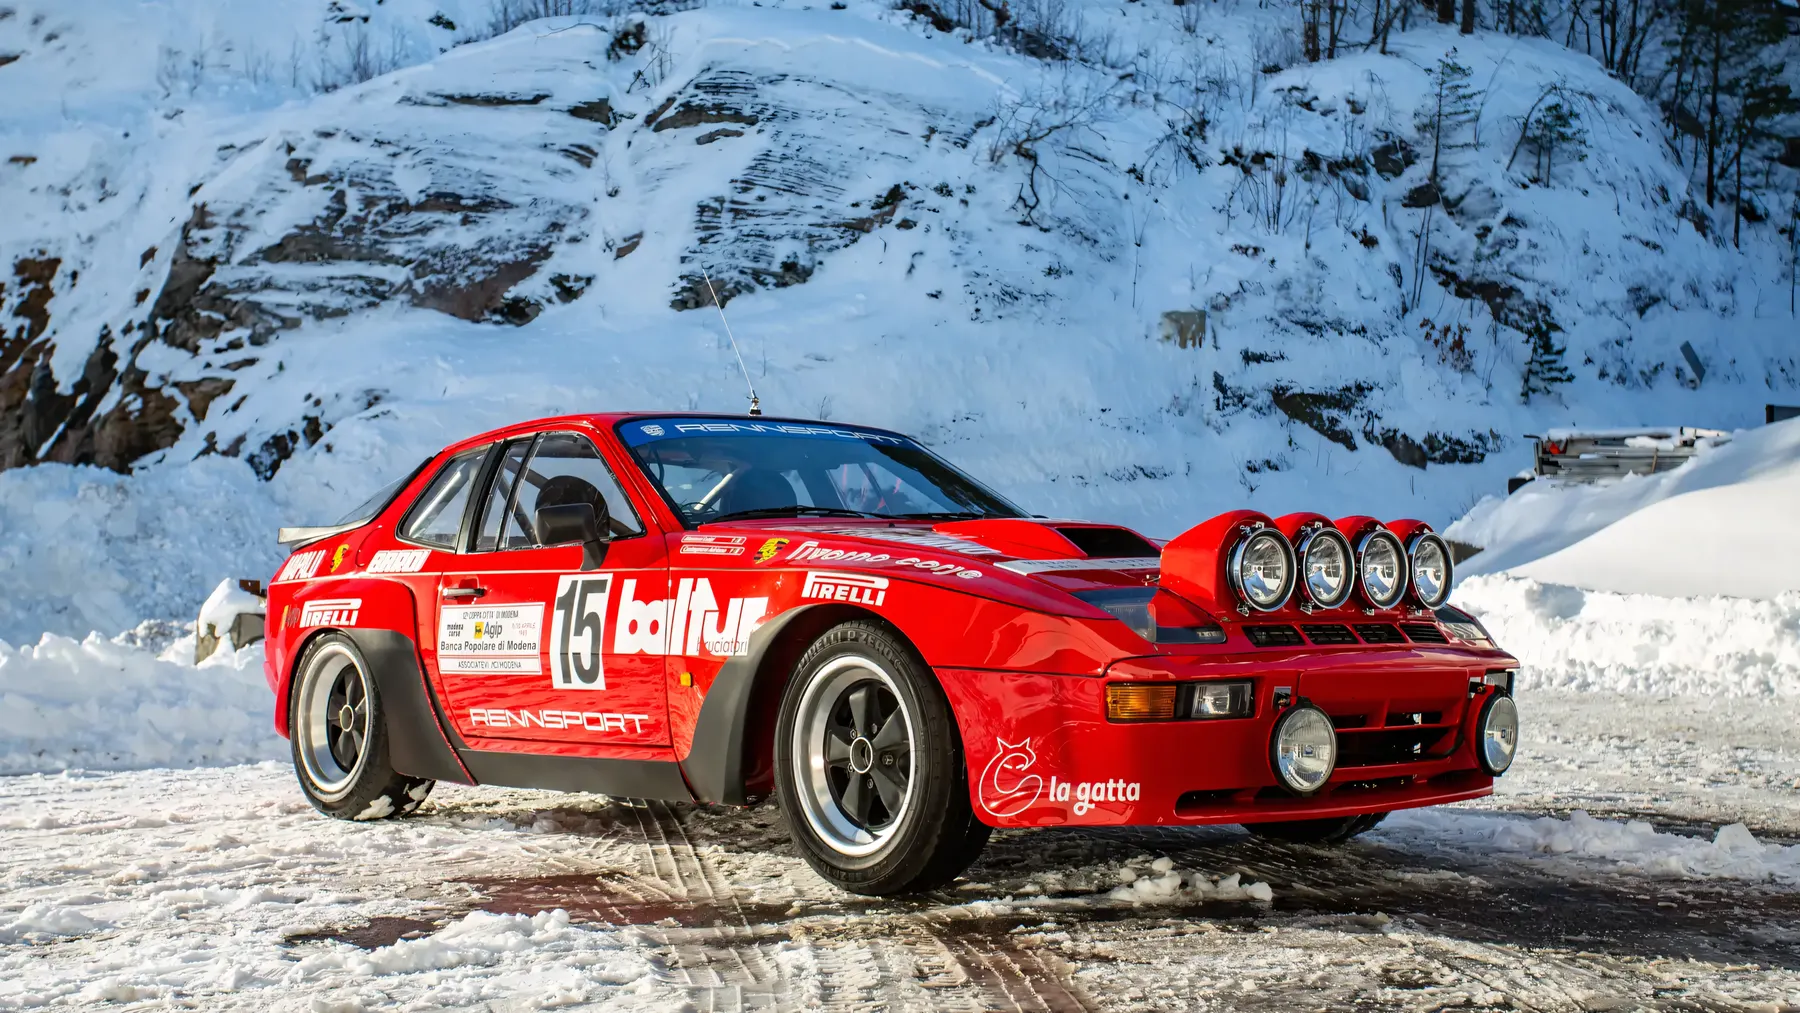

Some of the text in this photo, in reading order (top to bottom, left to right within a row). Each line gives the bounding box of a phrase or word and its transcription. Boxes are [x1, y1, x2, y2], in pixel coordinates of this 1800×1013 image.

[674, 423, 903, 445] RENNSPORT
[365, 550, 432, 573] BARDI
[801, 571, 889, 606] PIRELLI
[299, 598, 362, 628] PIRELLI
[613, 577, 769, 656] baltur
[483, 621, 503, 639] Agip
[555, 579, 607, 684] 15
[846, 630, 856, 642] P
[441, 640, 537, 654] Banca Popolare di Modena
[696, 636, 748, 653] bruciatori
[499, 660, 522, 669] MODENA
[469, 708, 649, 734] RENNSPORT
[1049, 776, 1141, 816] la gatta
